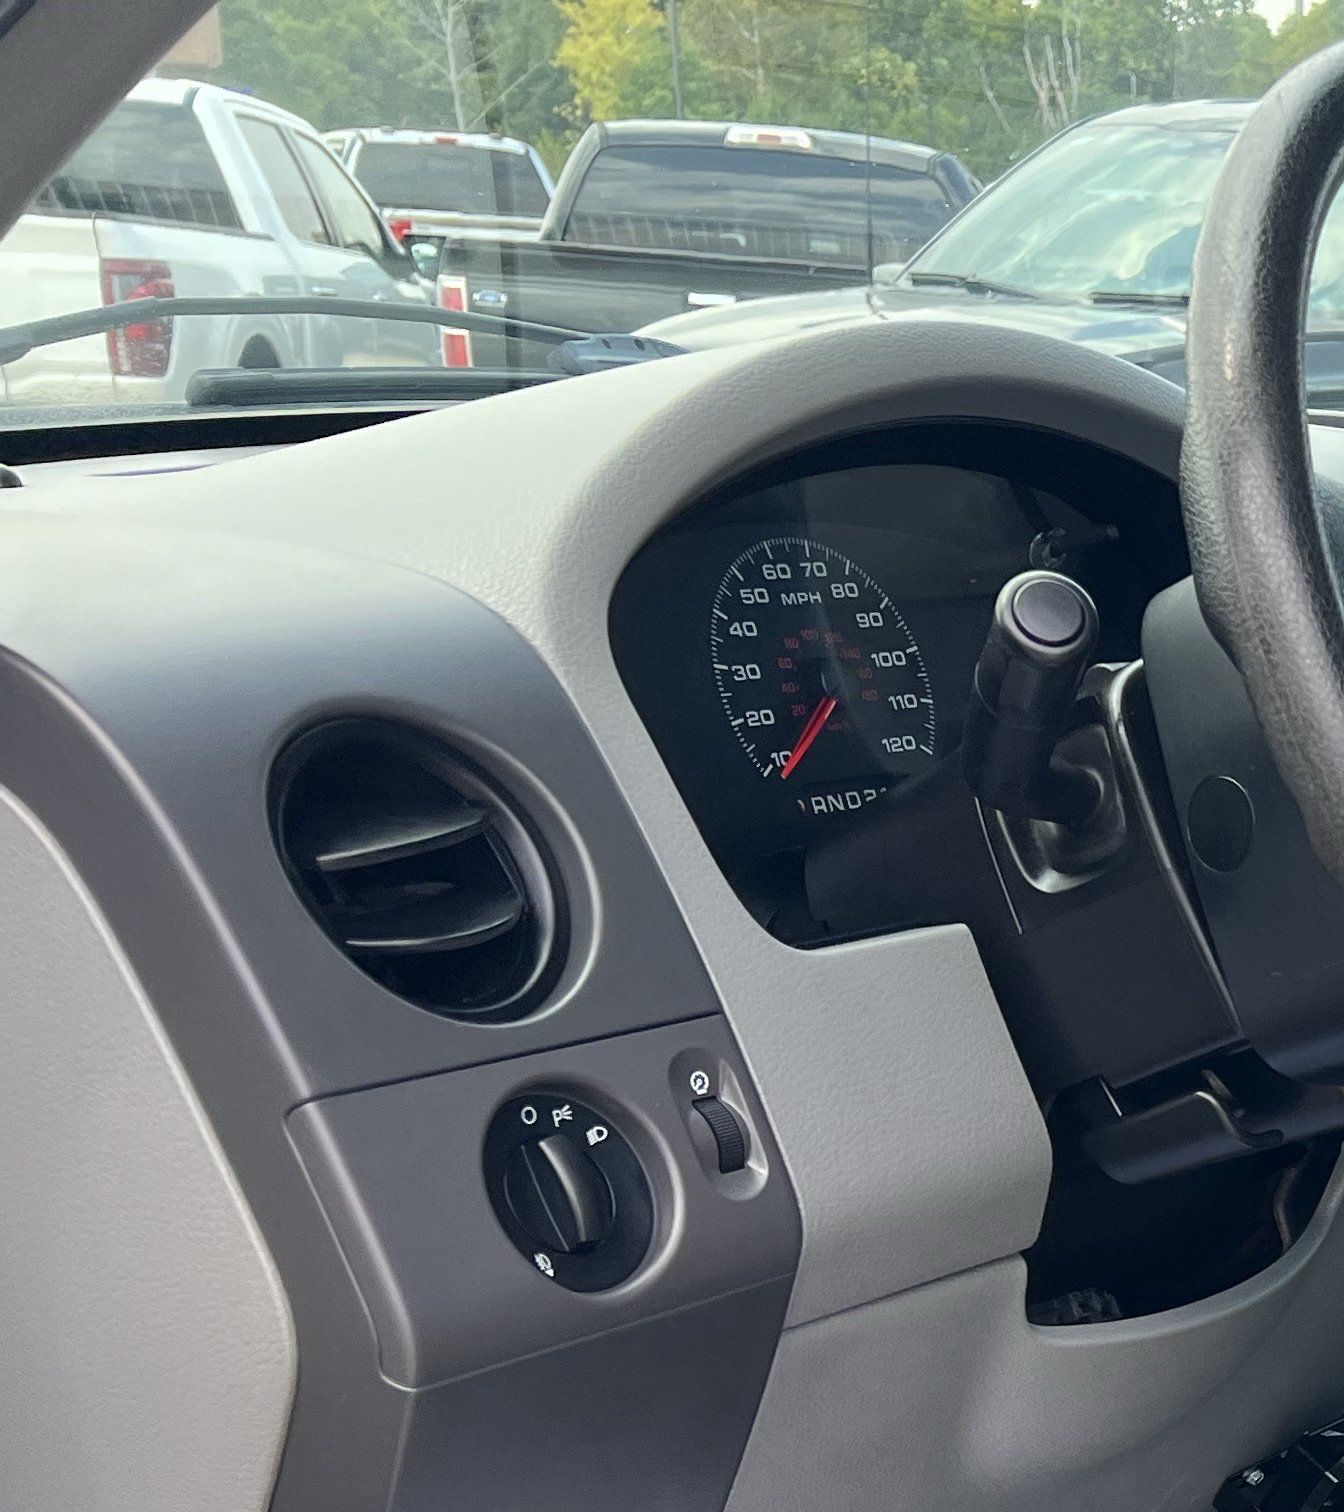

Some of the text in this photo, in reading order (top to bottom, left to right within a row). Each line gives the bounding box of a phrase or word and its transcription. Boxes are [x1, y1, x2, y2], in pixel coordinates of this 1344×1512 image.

[762, 563, 792, 580] 60
[800, 562, 828, 578] 70
[740, 588, 770, 604] 50
[780, 591, 823, 606] MPH
[830, 582, 859, 599] 80
[855, 612, 884, 628] 90
[729, 621, 758, 638] 40
[870, 650, 907, 668] 100
[731, 663, 762, 681] 30
[888, 693, 918, 711] 110
[745, 709, 776, 728] 20
[881, 735, 917, 753] 120
[770, 750, 792, 767] 10
